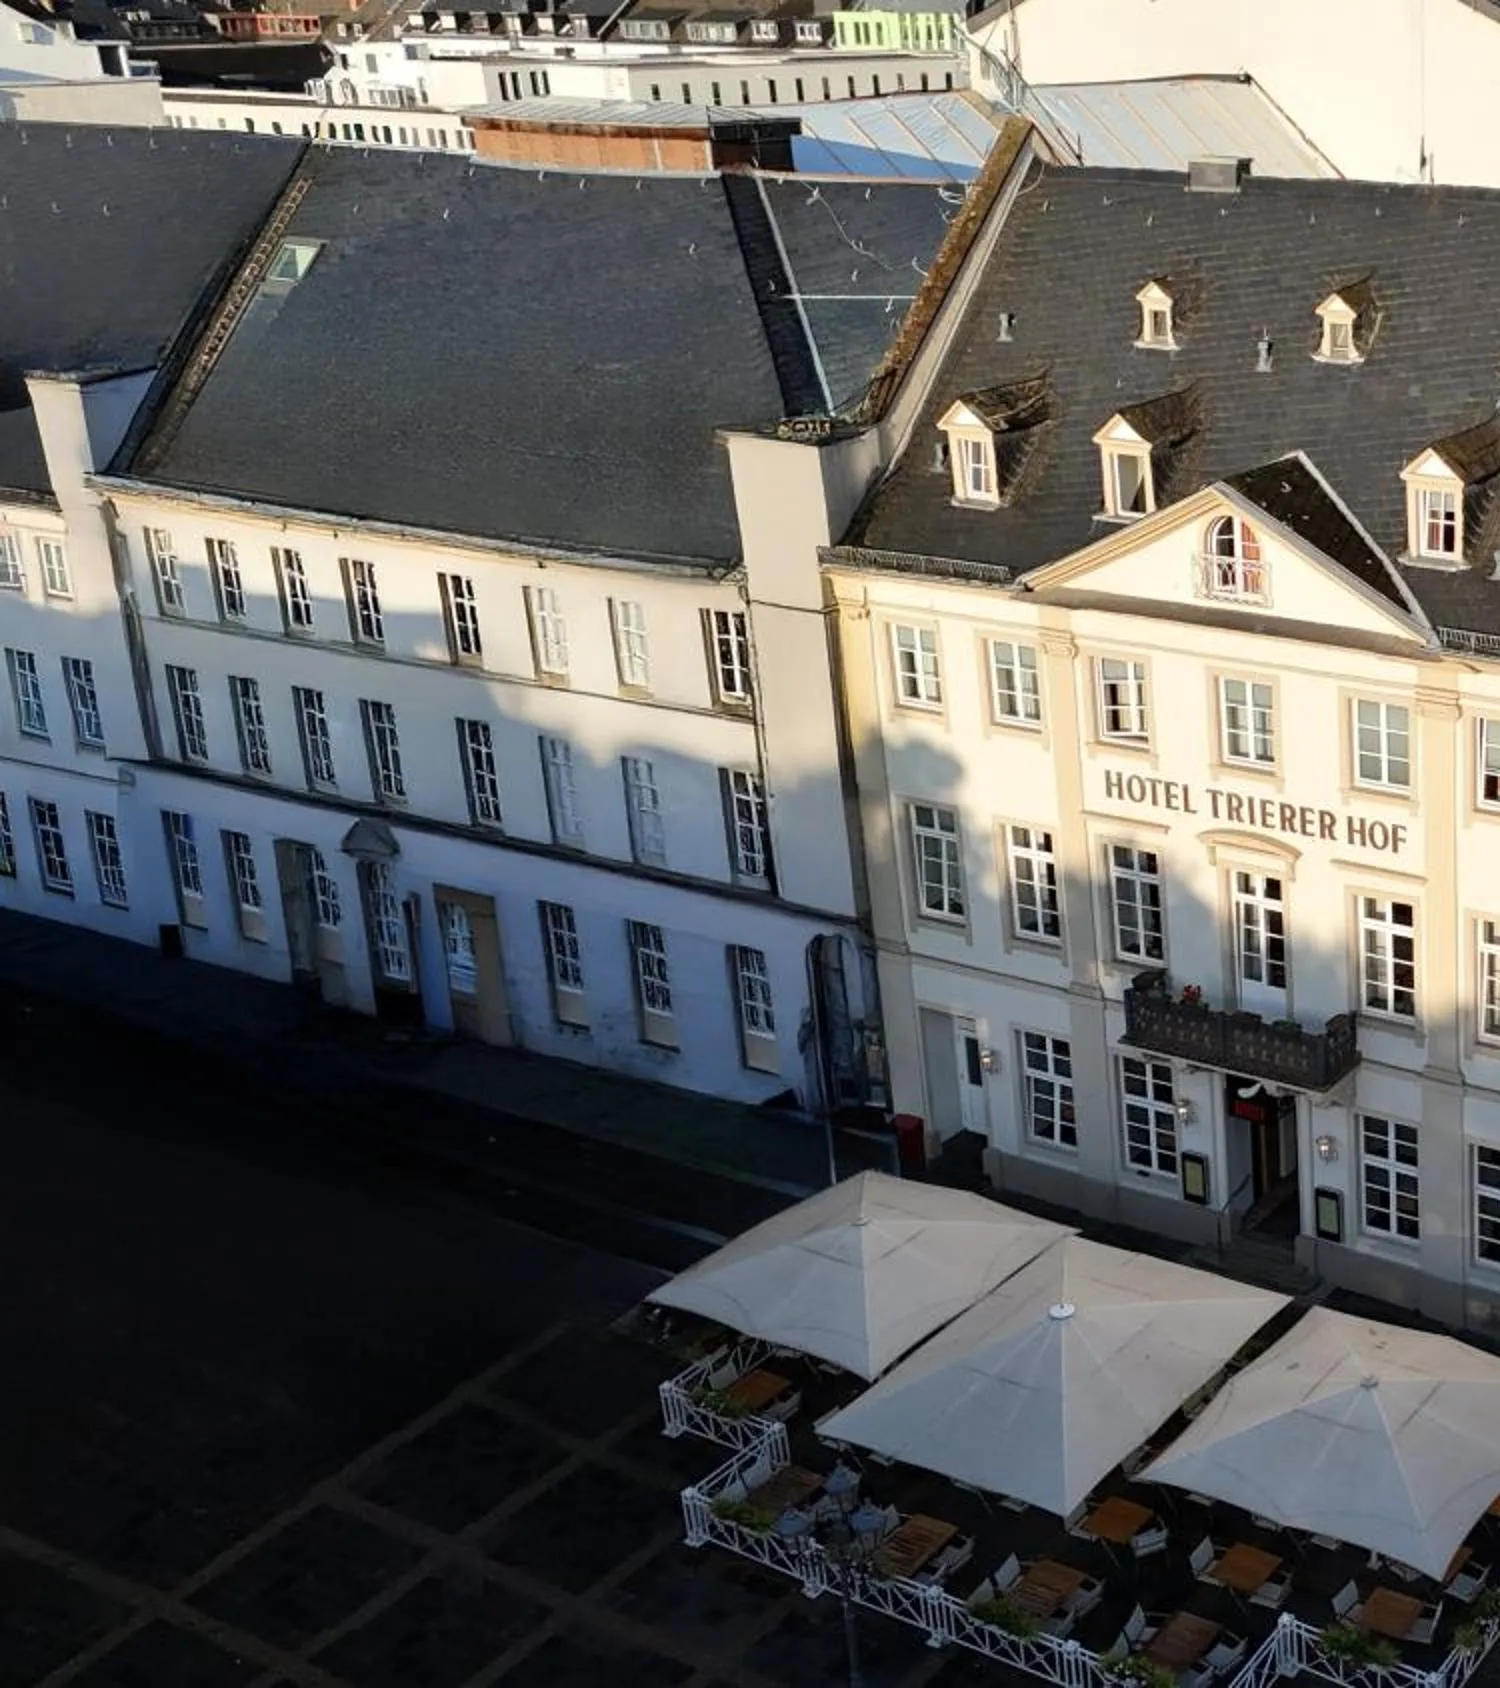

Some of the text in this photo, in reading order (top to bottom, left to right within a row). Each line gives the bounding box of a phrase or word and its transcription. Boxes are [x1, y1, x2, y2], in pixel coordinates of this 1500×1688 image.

[1104, 769, 1408, 854] HOTEL TRIERER HOF
